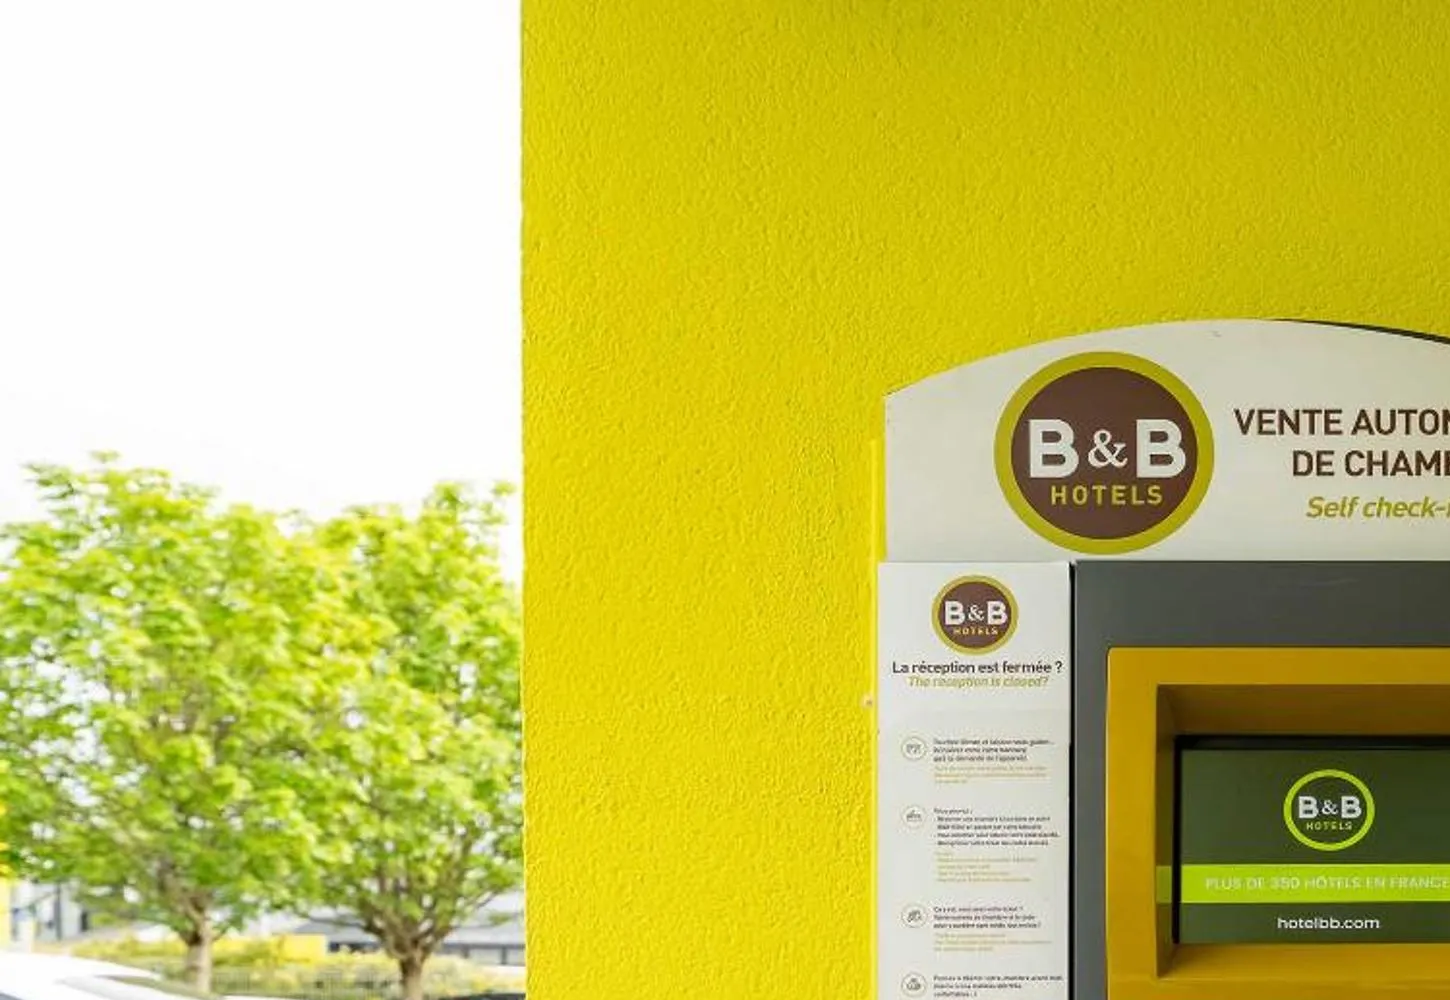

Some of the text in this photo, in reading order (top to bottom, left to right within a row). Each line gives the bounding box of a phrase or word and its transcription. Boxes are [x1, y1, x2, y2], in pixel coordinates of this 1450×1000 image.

[1233, 408, 1344, 437] VENTE
[1292, 449, 1338, 478] DE
[1050, 484, 1164, 507] HOTELS
[1304, 495, 1360, 519] Self
[892, 660, 1063, 676] La réception est fermée ?
[1205, 877, 1241, 890] PLUS
[1246, 877, 1264, 889] DE
[1305, 873, 1360, 889] HÔTELS
[1366, 876, 1385, 889] EN
[1390, 876, 1450, 889] FRANCE
[1277, 917, 1380, 930] hotelbb.com
